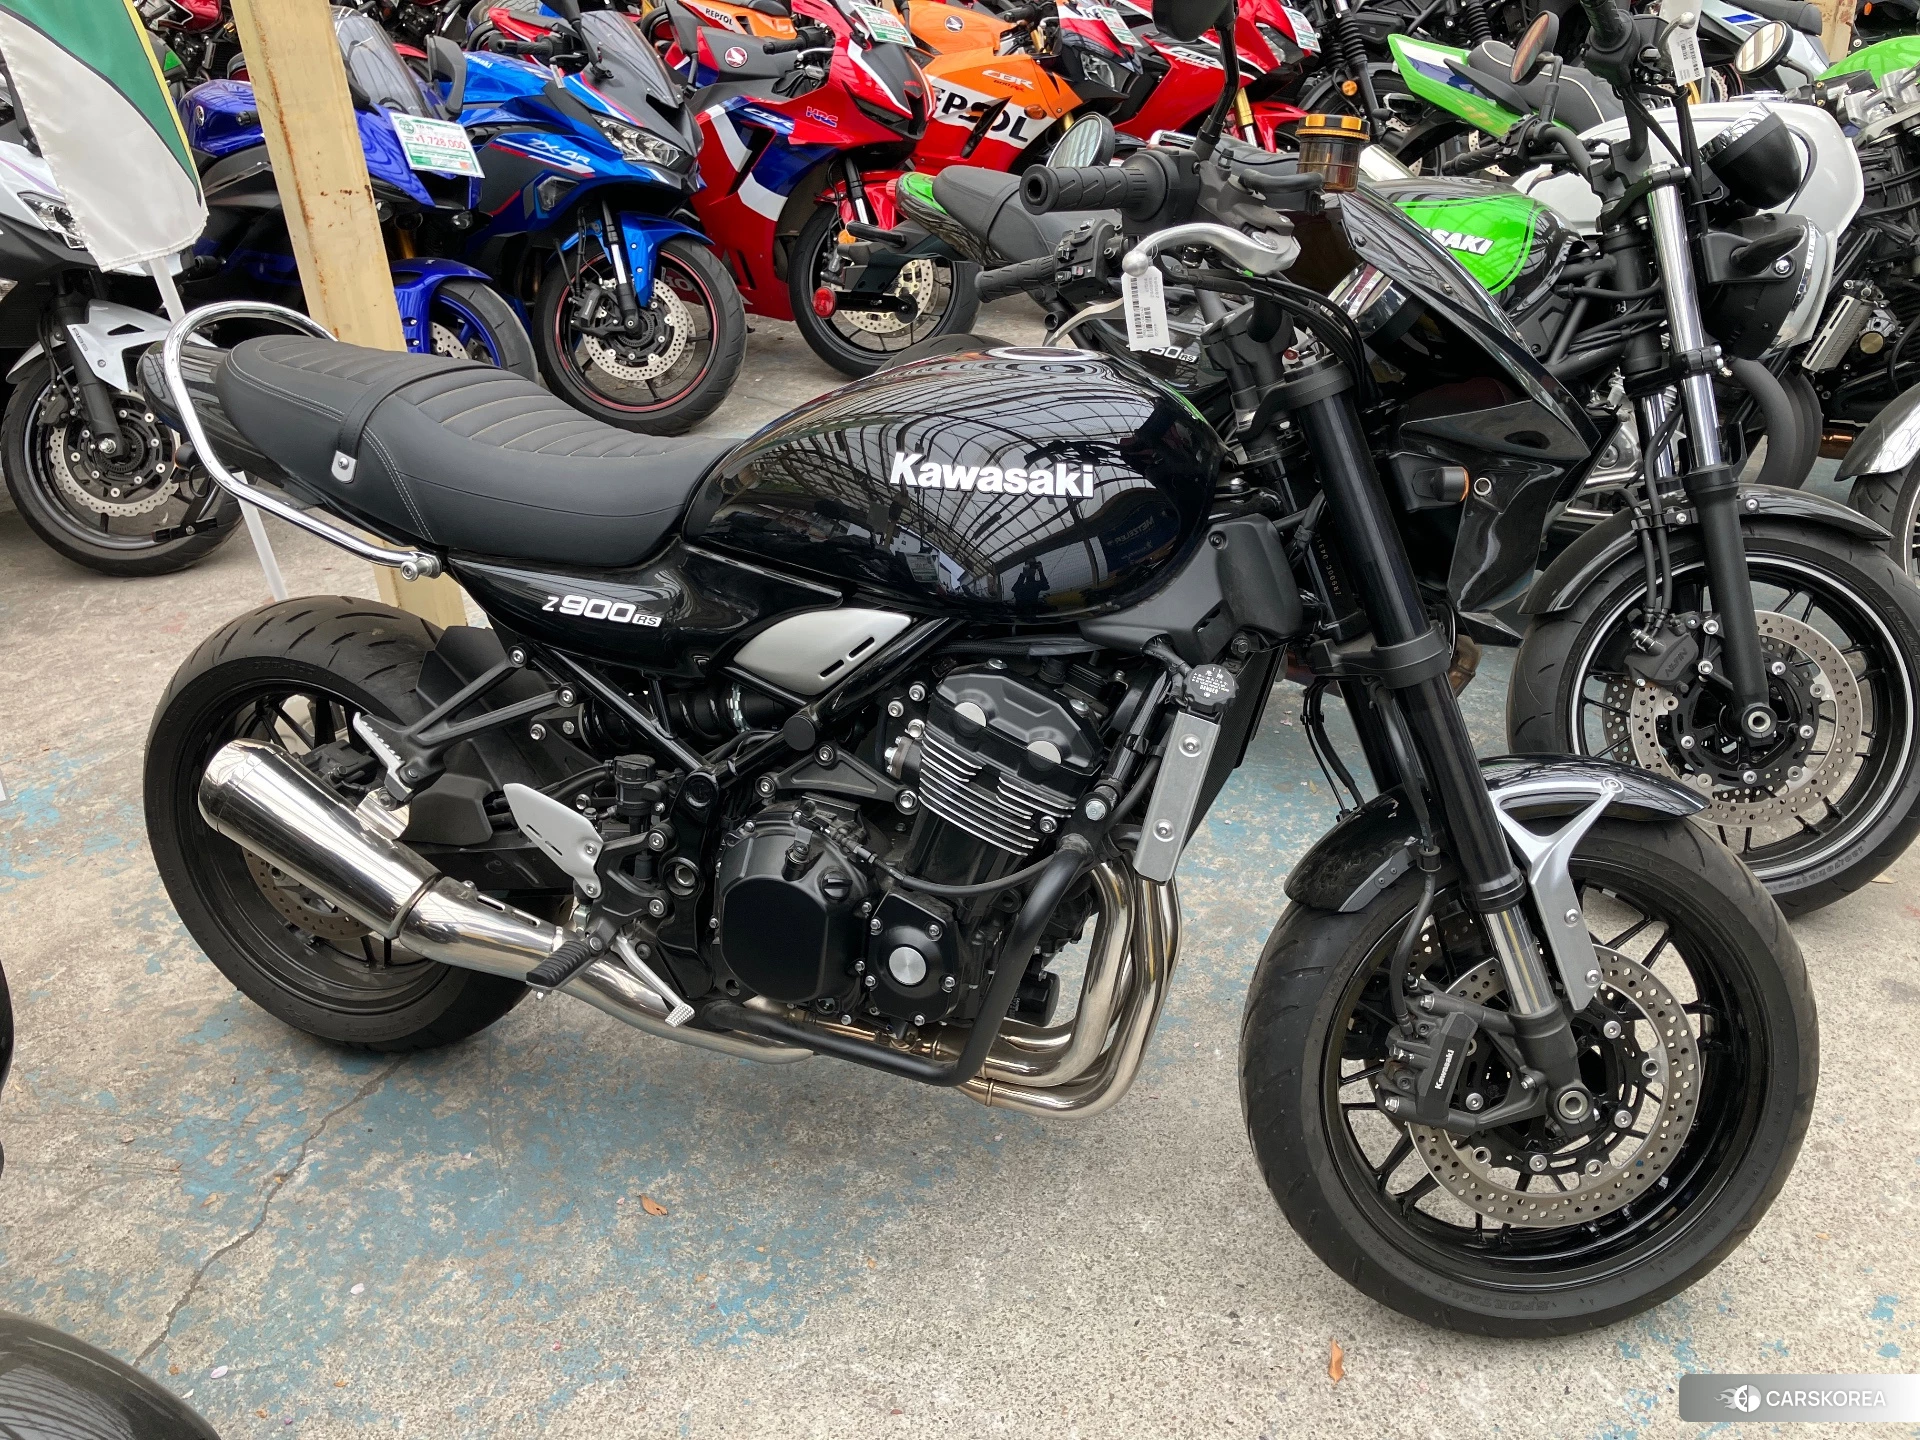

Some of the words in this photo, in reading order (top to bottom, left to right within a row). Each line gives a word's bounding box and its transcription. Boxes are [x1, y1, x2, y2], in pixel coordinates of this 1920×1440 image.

[704, 8, 734, 26] REPSOL
[981, 69, 1035, 91] CBR
[805, 105, 839, 128] HRC
[527, 138, 591, 166] ZX-4R
[890, 452, 1094, 499] Kawasaki
